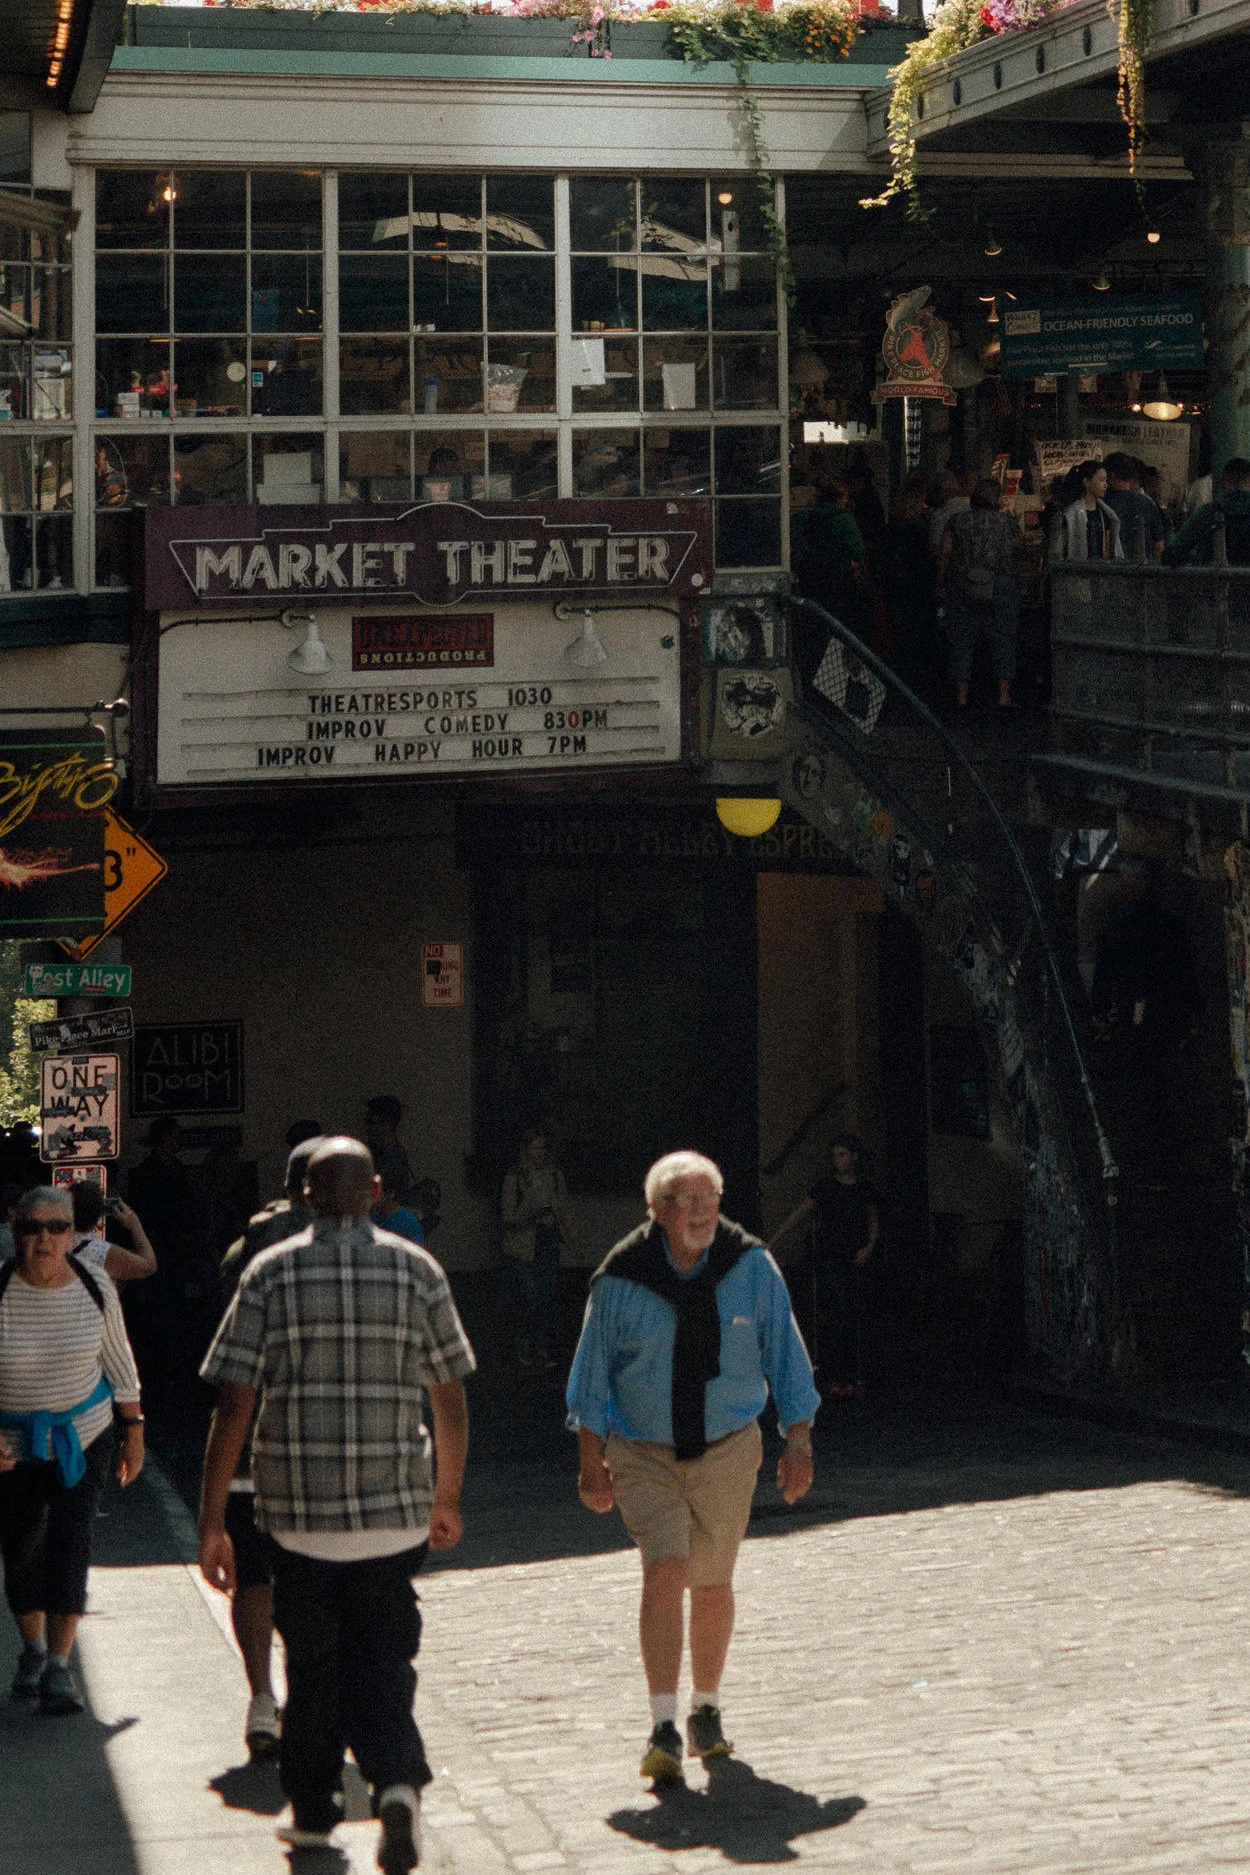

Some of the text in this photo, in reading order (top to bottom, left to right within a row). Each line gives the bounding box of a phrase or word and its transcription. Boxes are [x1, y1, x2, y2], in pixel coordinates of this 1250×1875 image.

[1043, 316, 1138, 333] OCEAN-FRIENDLY
[1140, 312, 1195, 326] SEAFOOD
[196, 537, 670, 590] MARKET THEATER
[307, 690, 478, 714] THEATRESPORTS
[307, 710, 608, 739] IMPROV COMEDY 830PM
[257, 735, 587, 766] IMPROV HAPPY HOUR 7PM
[78, 968, 127, 993] Alley
[146, 1031, 231, 1067] ALIBI
